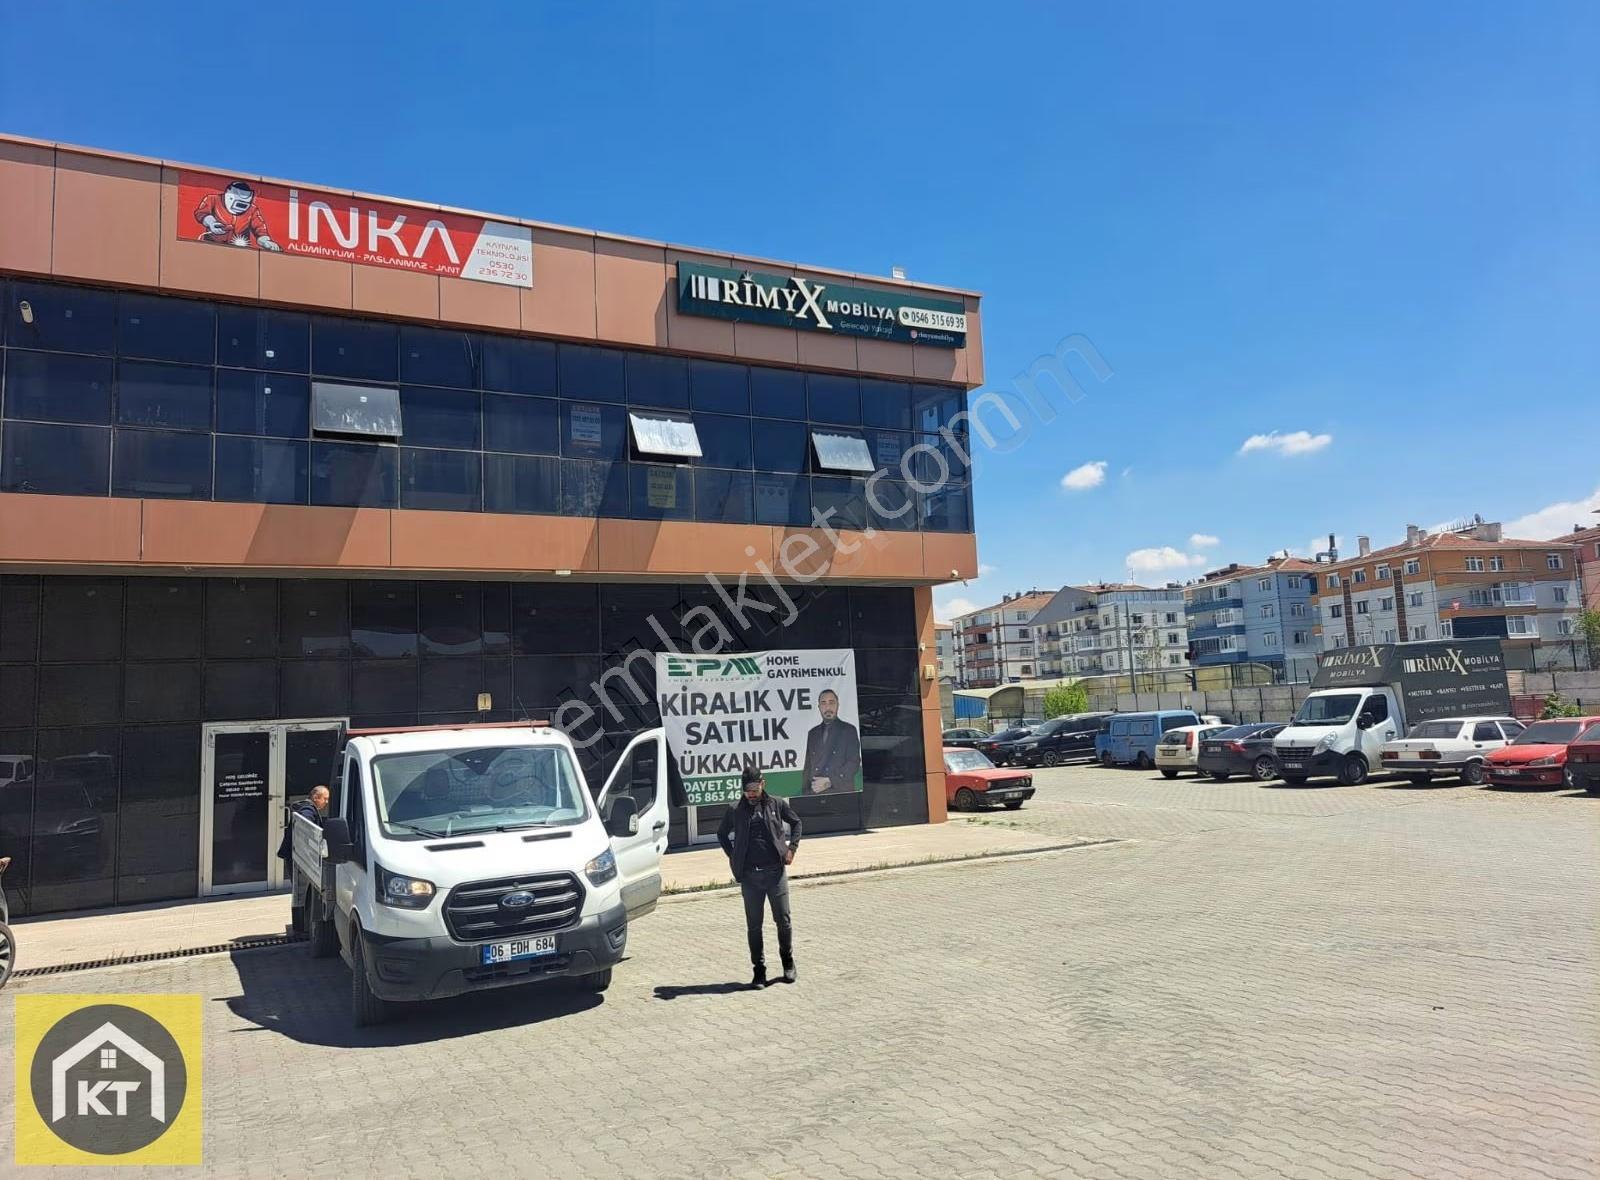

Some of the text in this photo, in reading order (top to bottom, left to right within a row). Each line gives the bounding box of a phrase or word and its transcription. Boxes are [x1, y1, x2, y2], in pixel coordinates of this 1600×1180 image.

[288, 189, 460, 264] İNKA
[287, 242, 355, 260] ALÜMİNYUM
[363, 254, 428, 270] PASLANMAZ
[435, 264, 460, 275] JANT
[489, 260, 514, 270] 0530
[827, 300, 895, 320] MOBİLYA
[911, 311, 964, 329] 0546 515 69 39
[766, 656, 799, 666] HOME
[1464, 655, 1500, 666] MOBİLYA
[661, 685, 812, 717] KİRALIK VE
[685, 717, 789, 745] SATILIK
[680, 749, 798, 776] ÜKKANLAR
[683, 778, 742, 793] DAYET SU
[704, 791, 725, 802] 863
[491, 937, 554, 957] 06 EDH 684
